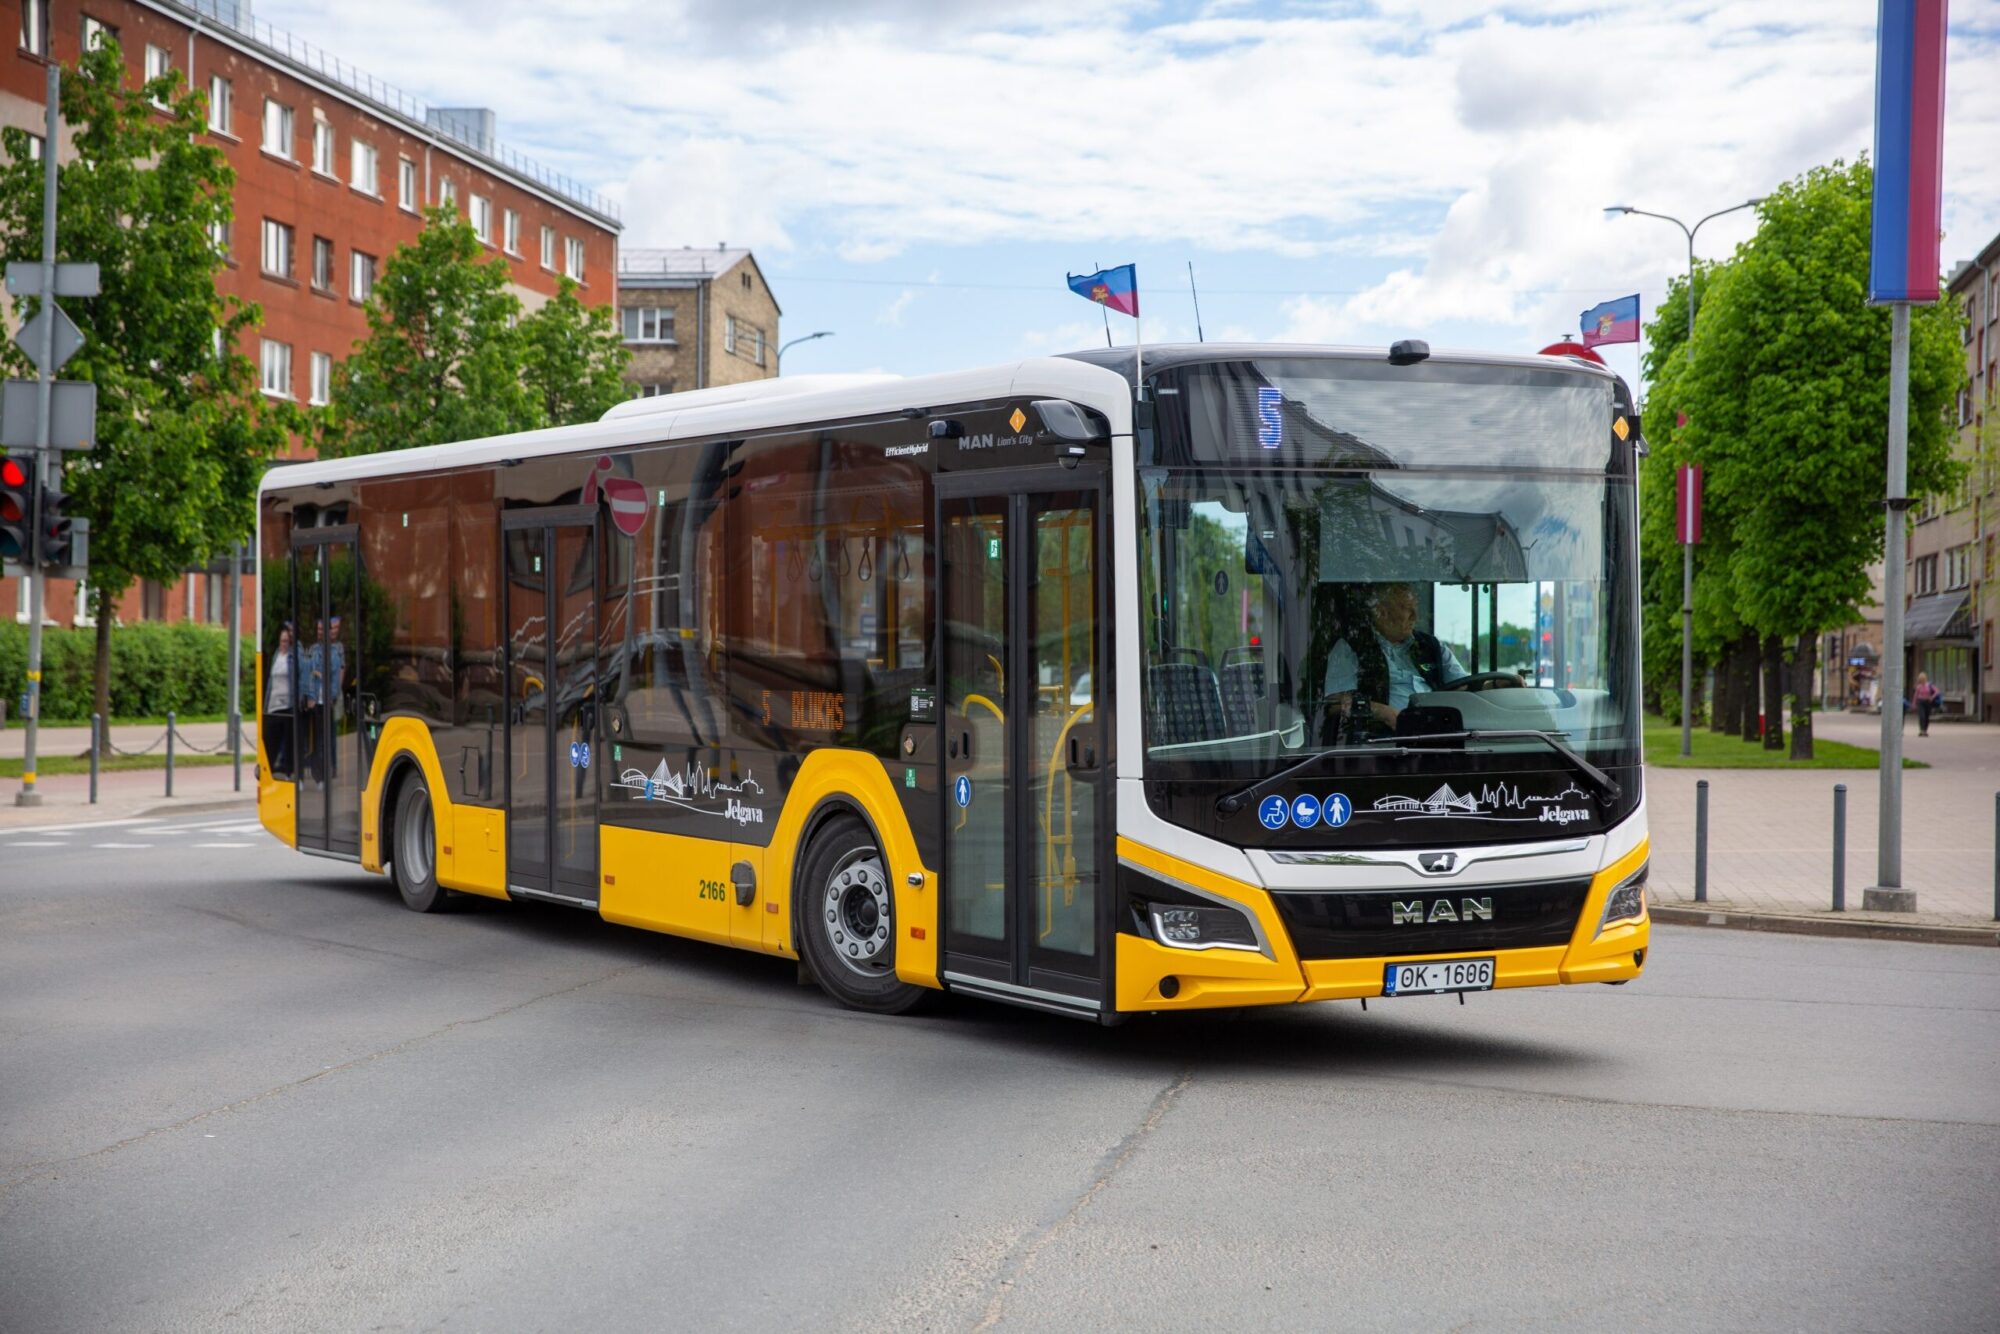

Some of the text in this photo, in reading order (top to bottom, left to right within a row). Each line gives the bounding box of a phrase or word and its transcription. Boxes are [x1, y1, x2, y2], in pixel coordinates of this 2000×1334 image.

[1258, 387, 1282, 449] 5
[885, 443, 928, 457] EfficientHybrid
[959, 433, 1033, 450] MAN Lion's City
[724, 798, 763, 826] Jelgava
[1538, 805, 1590, 826] Jelgava
[699, 880, 725, 901] 2166
[1392, 897, 1493, 925] MAN
[1401, 963, 1490, 988] OK-1606
